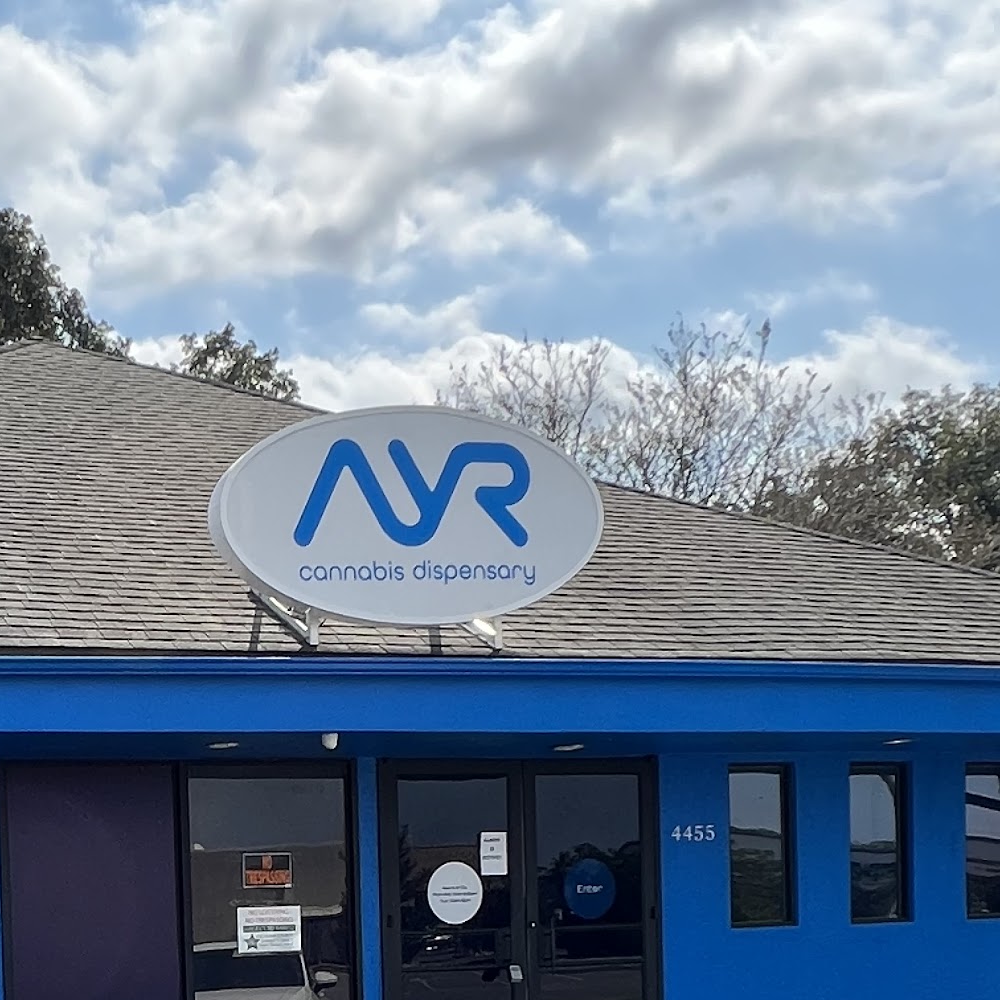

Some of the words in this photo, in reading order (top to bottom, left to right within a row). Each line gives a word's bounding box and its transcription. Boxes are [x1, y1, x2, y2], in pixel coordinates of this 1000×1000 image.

[294, 439, 530, 547] AYR
[299, 560, 404, 581] cannabis
[413, 560, 535, 585] dispensary
[671, 825, 715, 841] 4455
[576, 884, 603, 894] Enter
